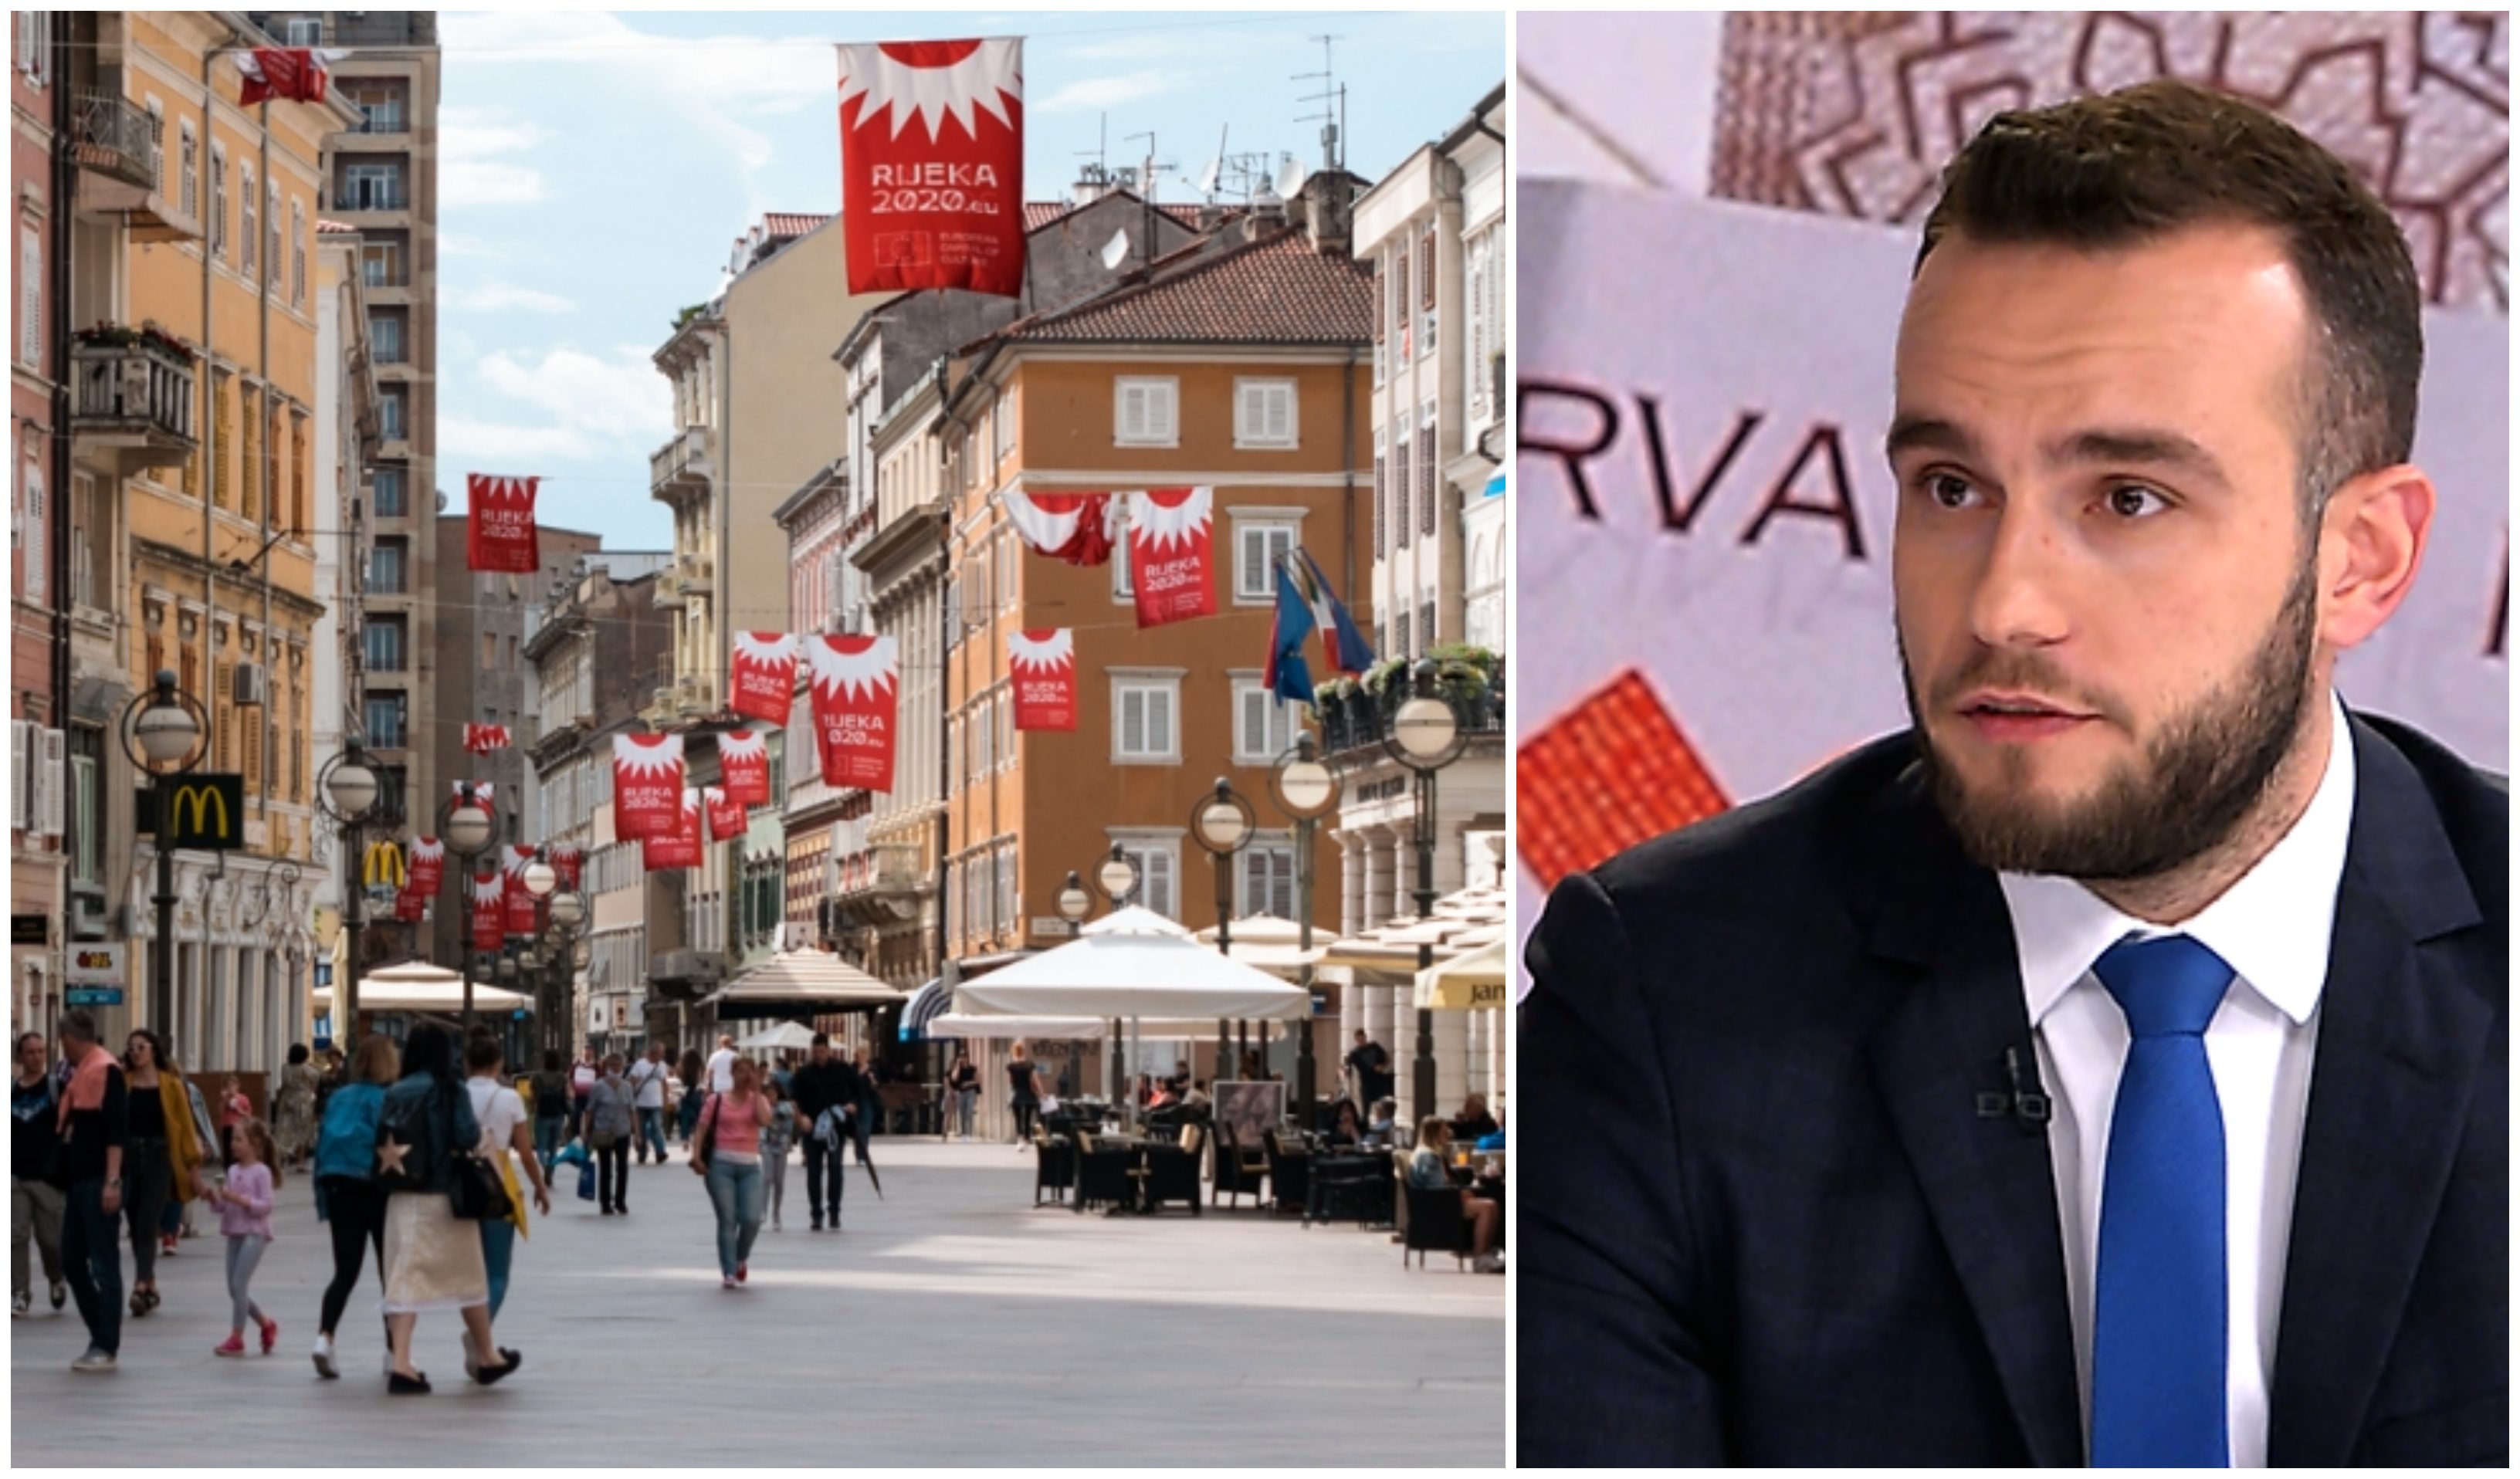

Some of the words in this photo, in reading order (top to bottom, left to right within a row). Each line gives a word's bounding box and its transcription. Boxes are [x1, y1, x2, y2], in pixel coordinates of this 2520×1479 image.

[872, 163, 998, 188] RIJEKA
[871, 189, 998, 215] 2020.eu
[1516, 377, 1868, 561] RVA
[1145, 557, 1201, 578] RIJEKA
[1022, 682, 1068, 692] RIJEKA
[623, 787, 673, 798] RIJEKA
